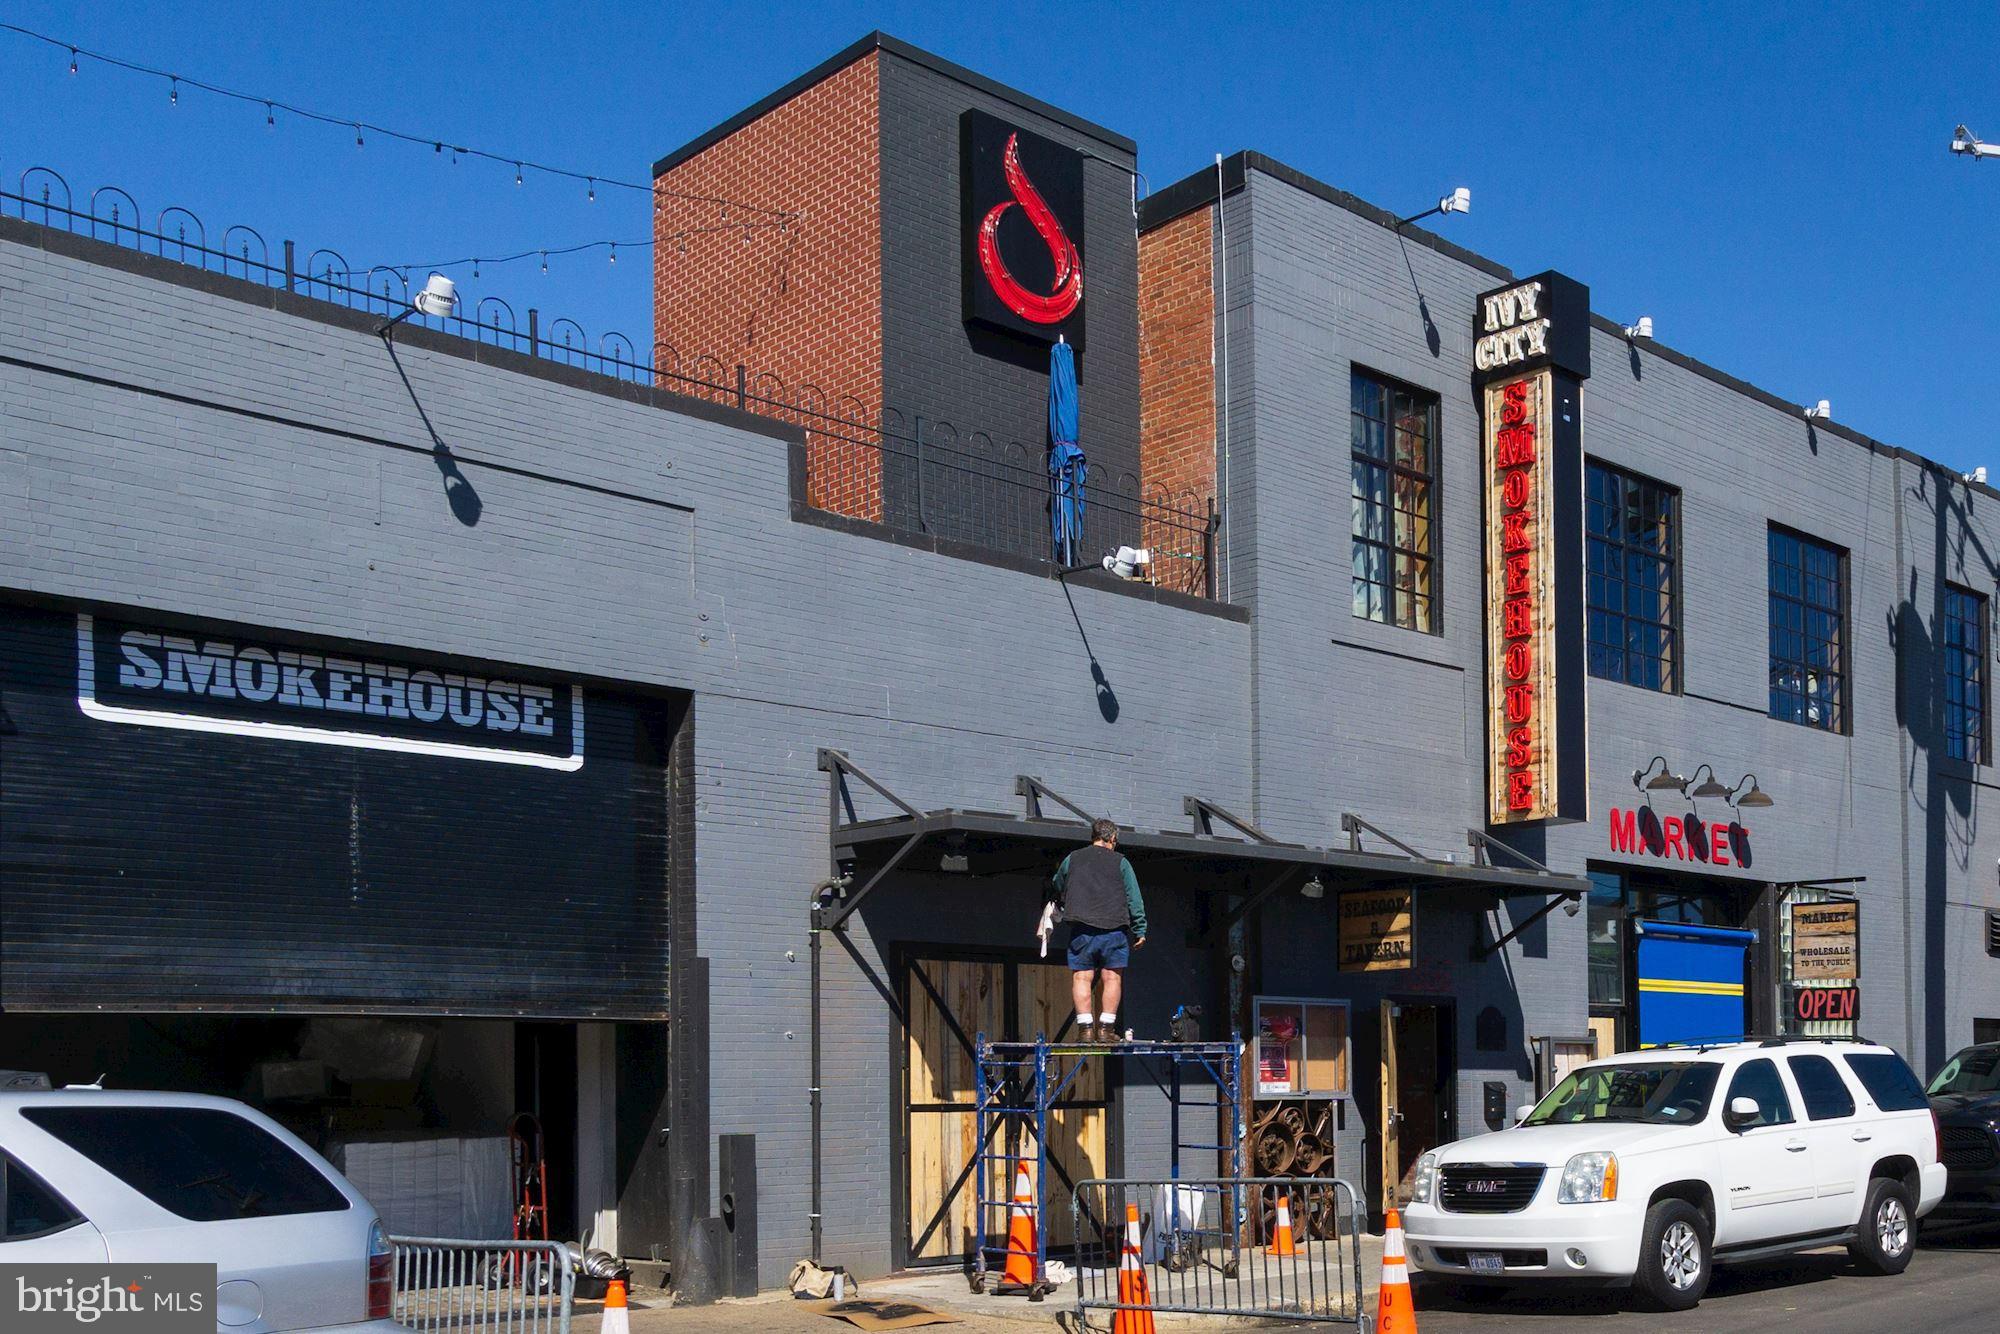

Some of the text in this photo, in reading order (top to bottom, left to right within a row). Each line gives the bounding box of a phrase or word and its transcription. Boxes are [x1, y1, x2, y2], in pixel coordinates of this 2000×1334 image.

[1484, 282, 1541, 332] IVY
[1475, 318, 1551, 371] CITY
[1497, 380, 1538, 811] SMOKEHOUSE
[119, 630, 554, 736] SMOKEHOUSE
[1610, 808, 1749, 868] MARKET
[1344, 897, 1405, 917] SEAFOOD
[1801, 911, 1850, 924] MARKET
[1344, 940, 1405, 961] TAVERN
[1800, 946, 1850, 957] WHOLESALE
[1827, 958, 1850, 966] PUBLIC
[1798, 989, 1856, 1019] OPEN
[1466, 1180, 1506, 1192] GMC
